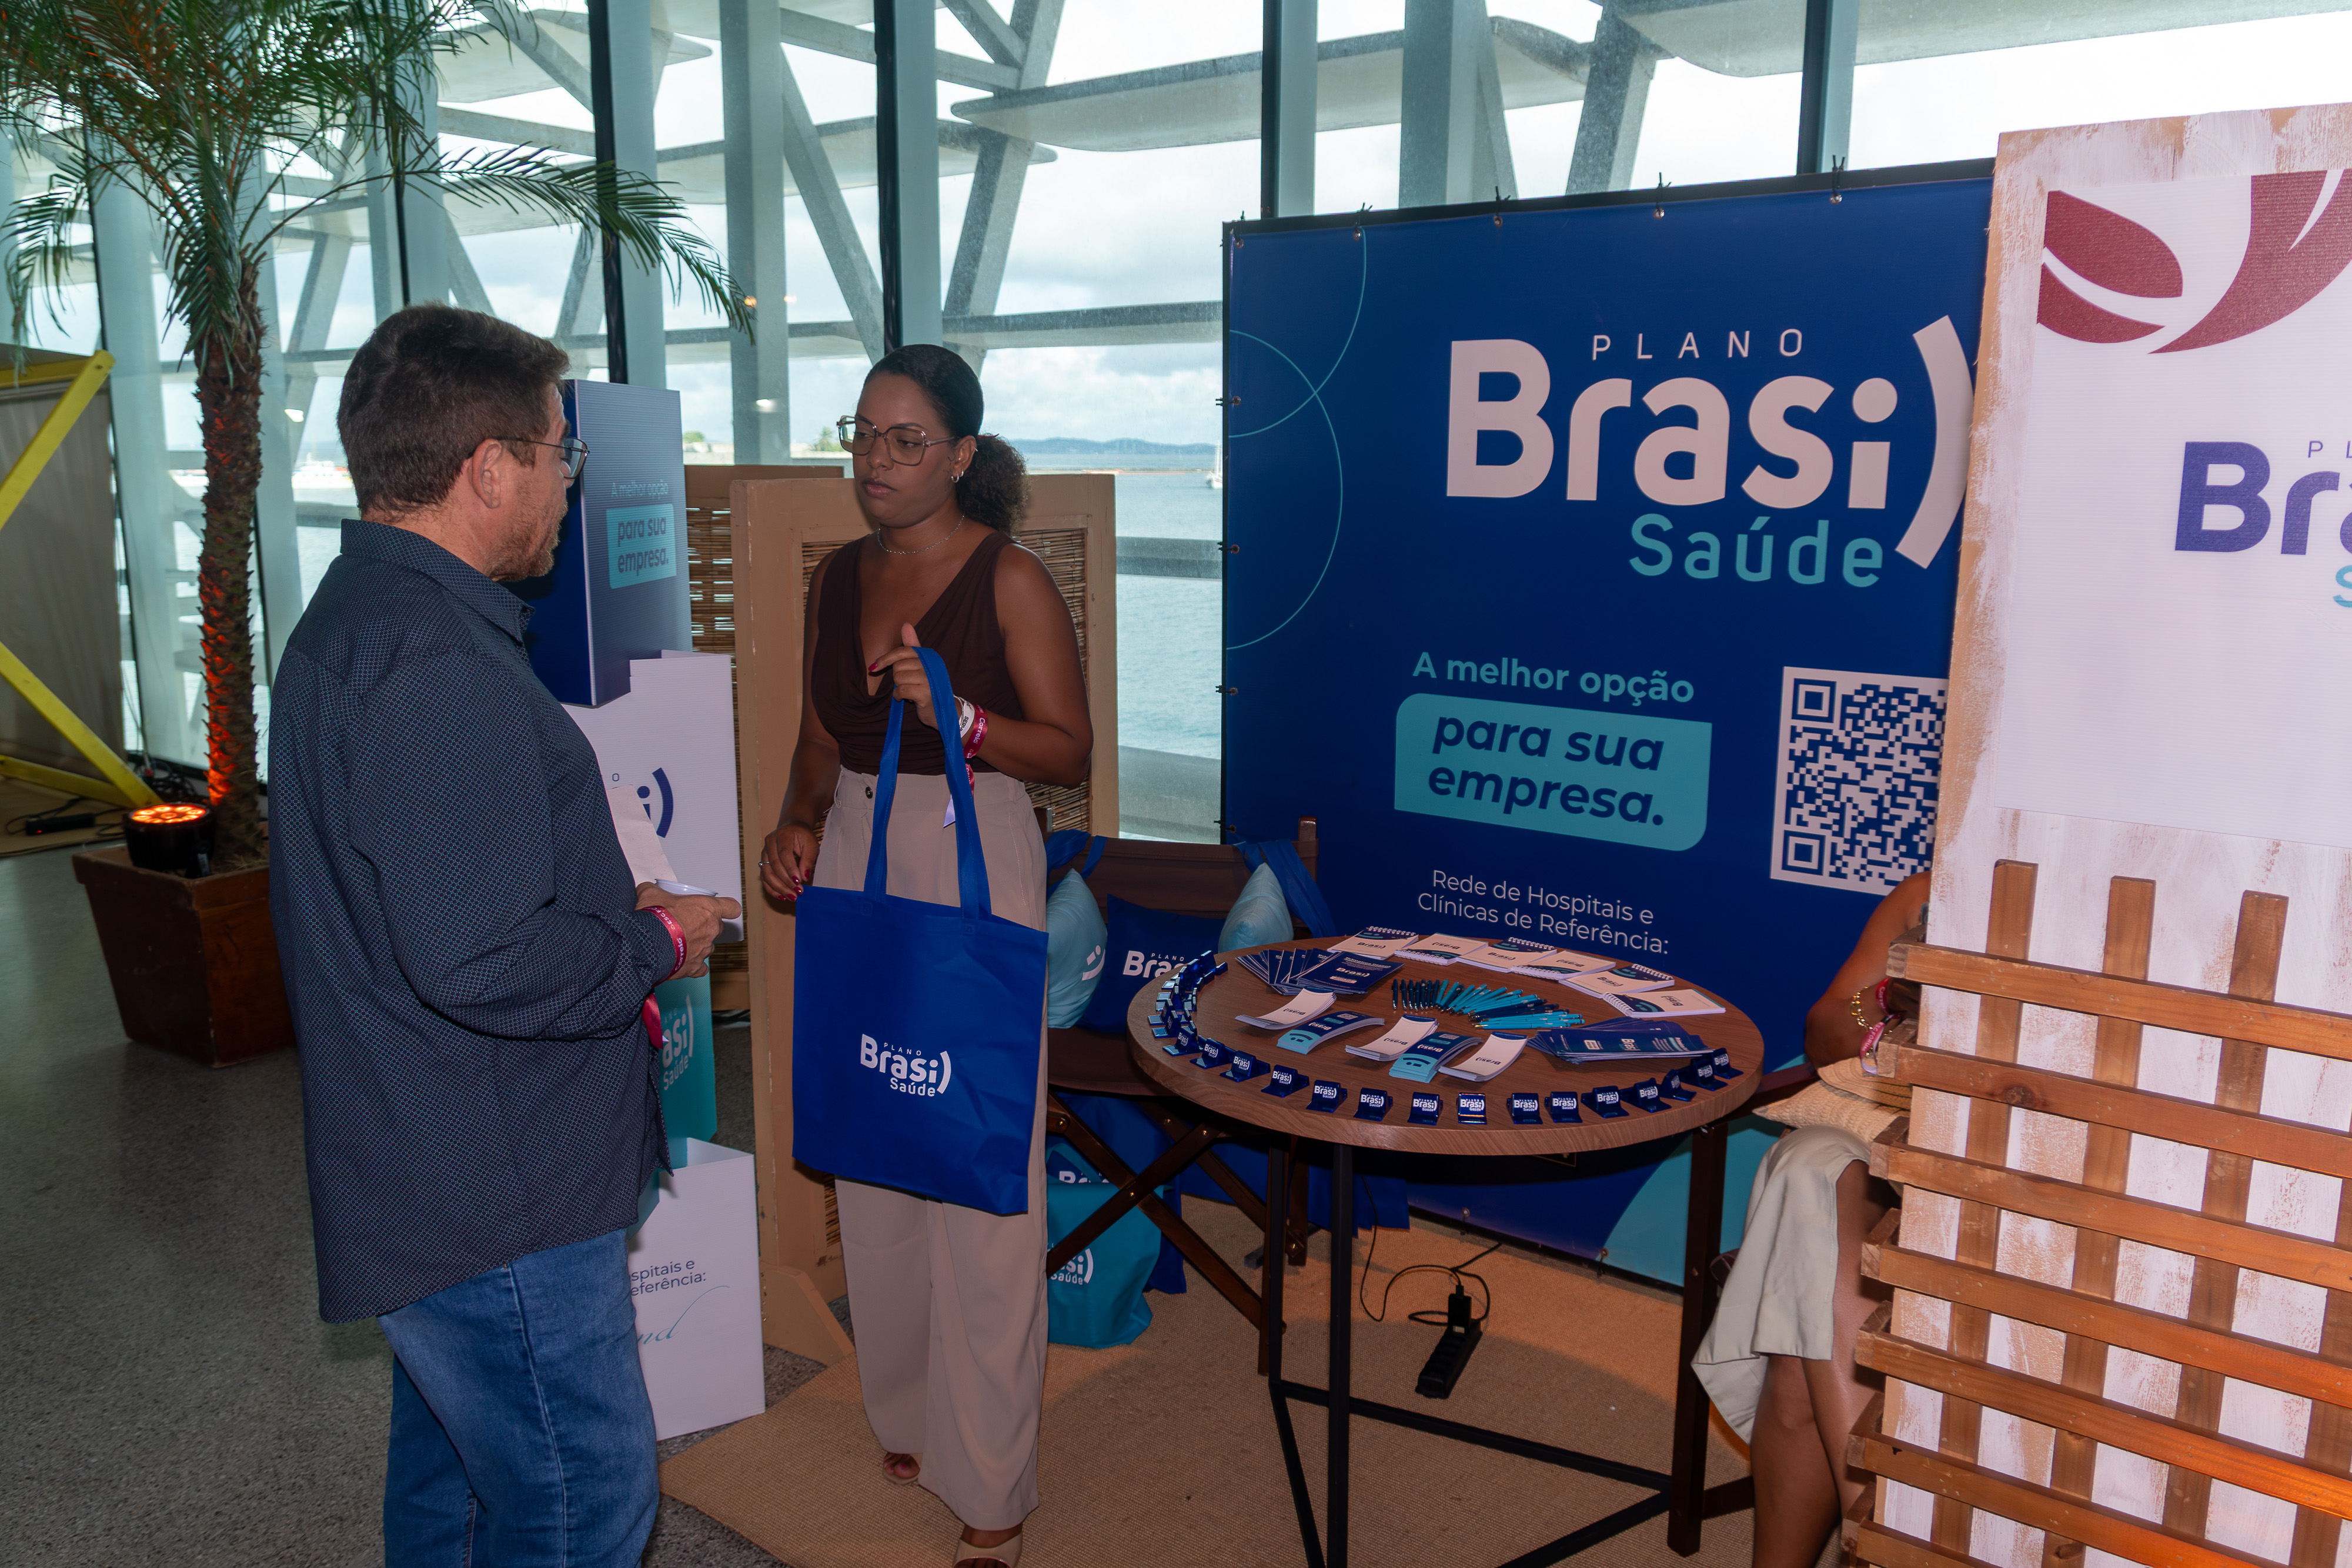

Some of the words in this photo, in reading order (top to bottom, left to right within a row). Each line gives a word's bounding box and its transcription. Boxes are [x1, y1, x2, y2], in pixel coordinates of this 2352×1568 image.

[1592, 328, 1803, 360] PLANO
[611, 482, 617, 497] A
[619, 480, 646, 497] melhor
[647, 479, 669, 500] opção
[617, 519, 645, 547] para
[647, 517, 666, 536] sua
[618, 547, 669, 576] empresa.
[1629, 512, 1883, 587] Saúde
[1412, 651, 1437, 679] A
[1446, 657, 1570, 691] melhor
[1579, 669, 1695, 707] opção
[973, 717, 985, 743] Correio
[1432, 716, 1552, 758] para
[1563, 731, 1665, 771] sua
[1428, 766, 1664, 825] empresa.
[1432, 870, 1487, 895] Rede
[1493, 881, 1521, 901] de
[1528, 886, 1633, 921] Hospitais
[1639, 909, 1654, 924] e
[1418, 892, 1499, 923] Clínicas
[1505, 908, 1533, 929] de
[1539, 913, 1669, 954] Referência:
[1151, 953, 1184, 961] PLANO
[884, 1042, 921, 1056] PLANO
[663, 1055, 689, 1091] Saúde
[890, 1077, 936, 1097] Saúde
[630, 1272, 706, 1296] eferência:
[631, 1261, 682, 1283] spitais
[686, 1260, 695, 1270] e
